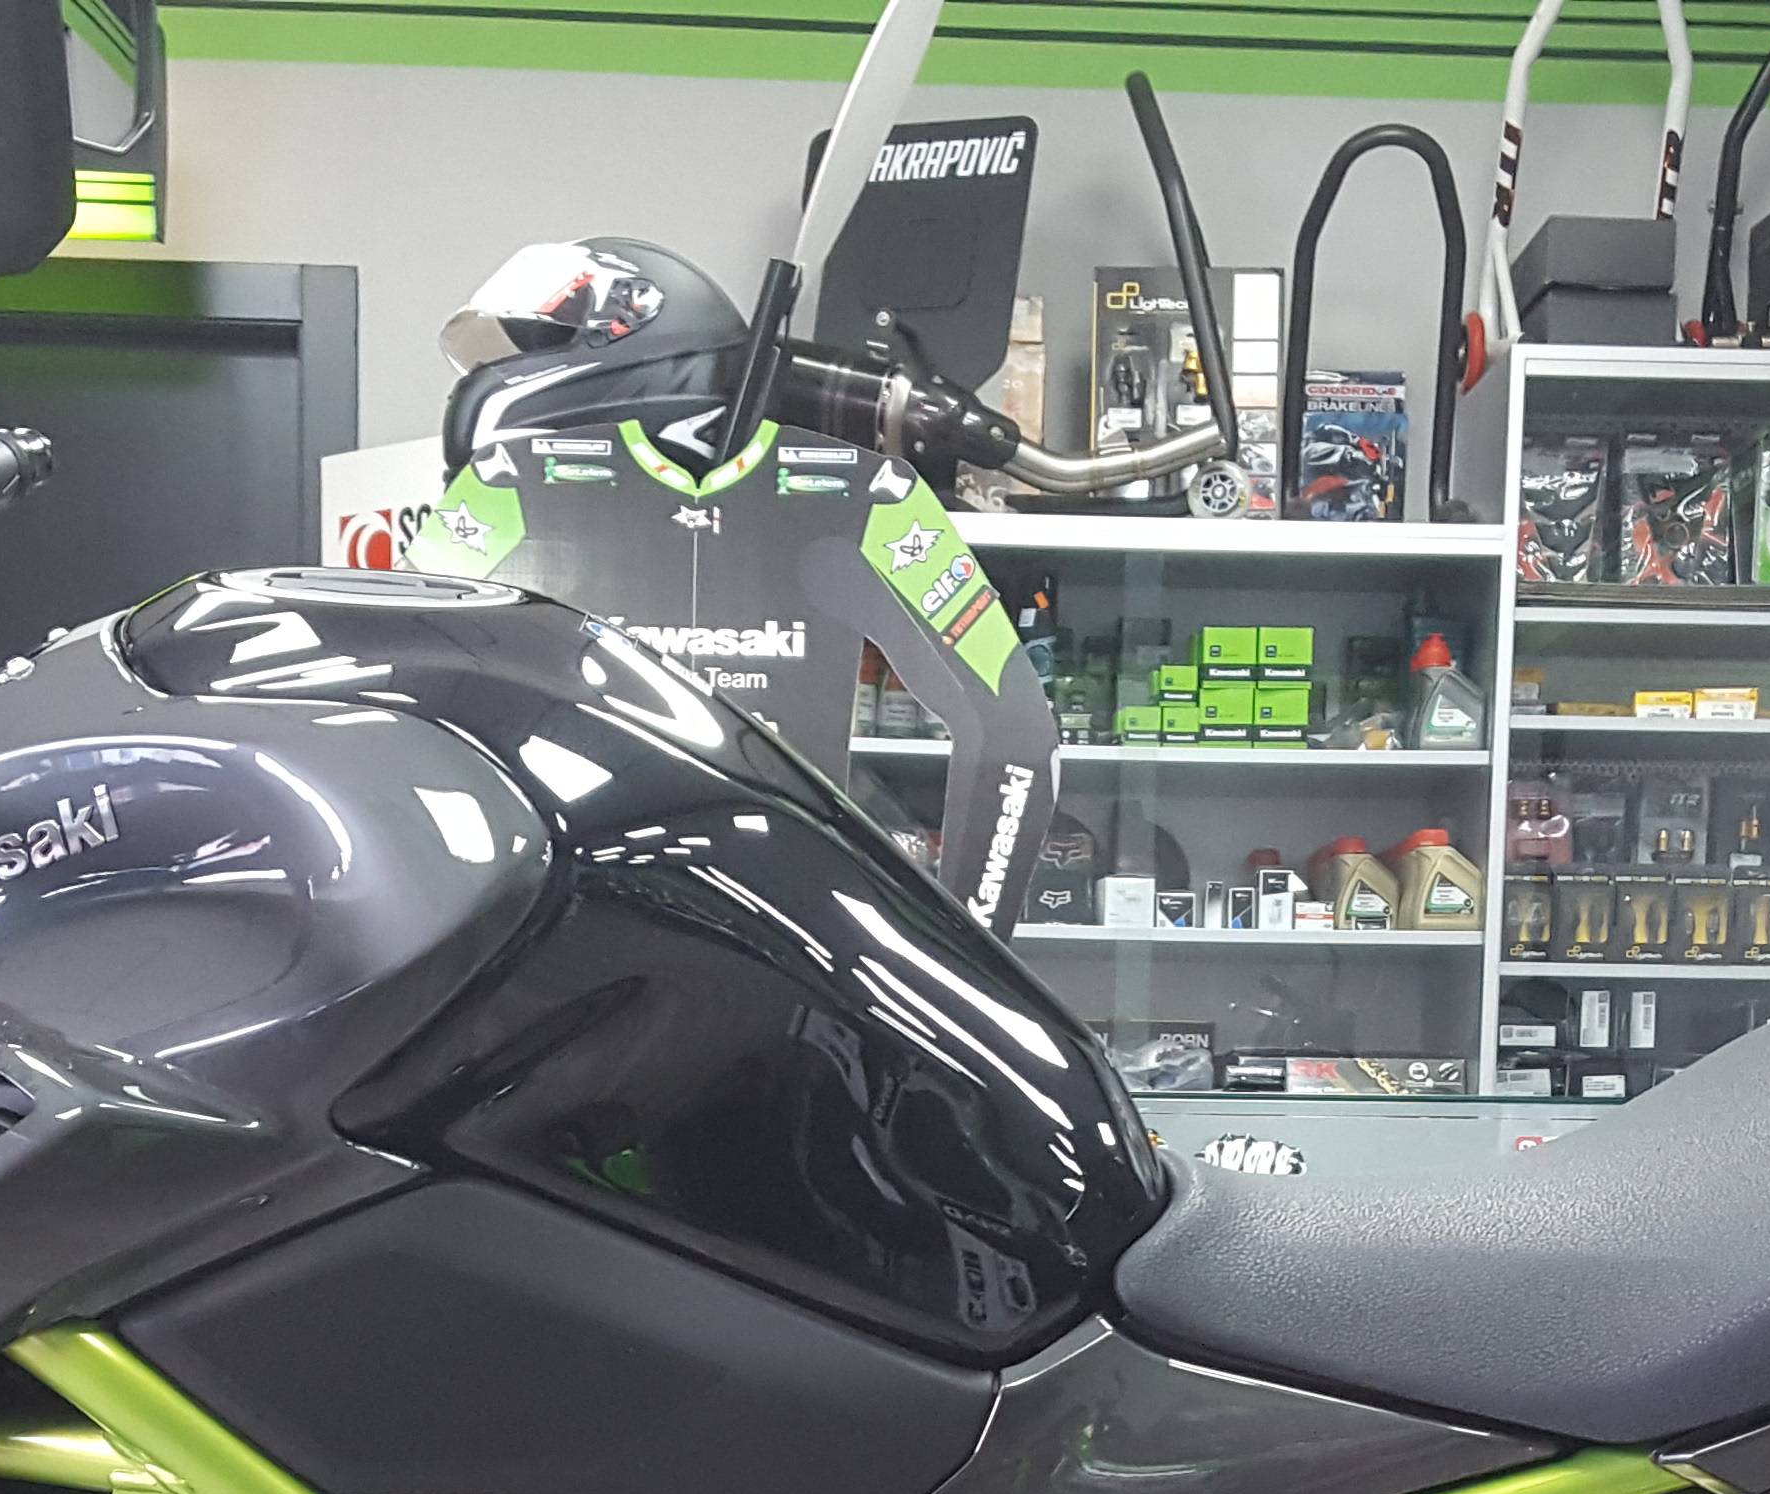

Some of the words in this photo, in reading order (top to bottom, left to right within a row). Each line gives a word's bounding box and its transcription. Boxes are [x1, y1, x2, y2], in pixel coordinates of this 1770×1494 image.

[608, 616, 806, 658] awasaki
[704, 666, 768, 690] Team
[967, 763, 1035, 928] Kawasaki
